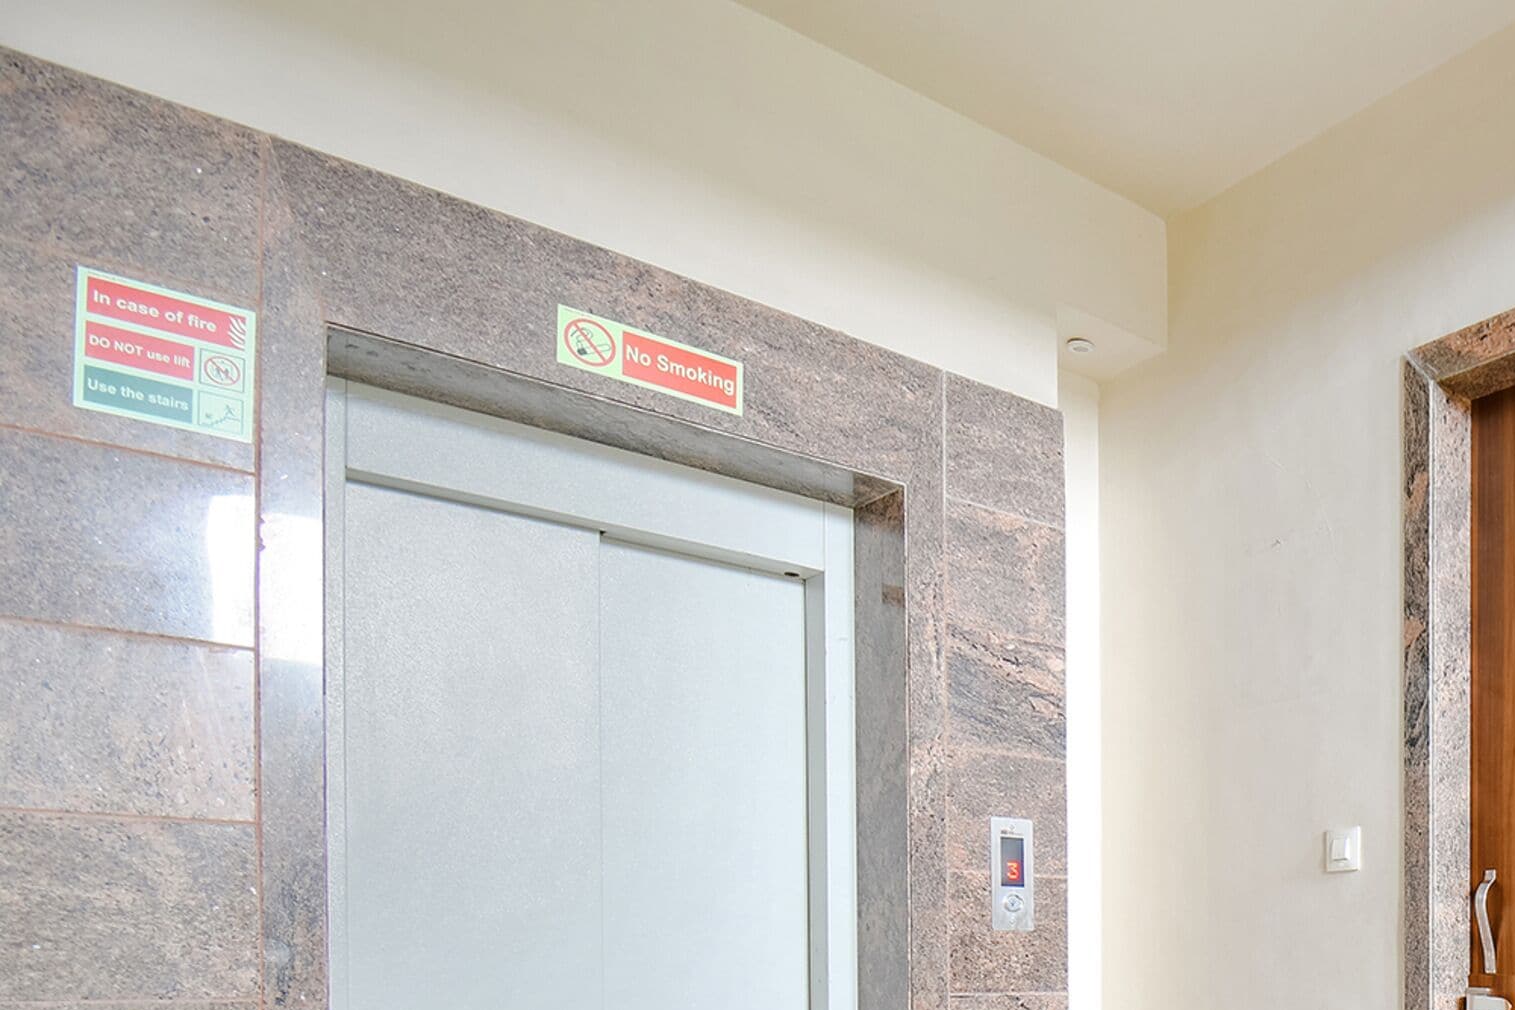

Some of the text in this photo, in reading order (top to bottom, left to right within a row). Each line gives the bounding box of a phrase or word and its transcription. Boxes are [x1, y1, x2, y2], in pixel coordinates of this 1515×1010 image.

[93, 289, 217, 332] In case of fire
[89, 334, 191, 369] DO NOT use lift
[626, 345, 735, 396] No Smoking
[87, 377, 189, 411] Use the stairs
[1006, 861, 1020, 880] 3
